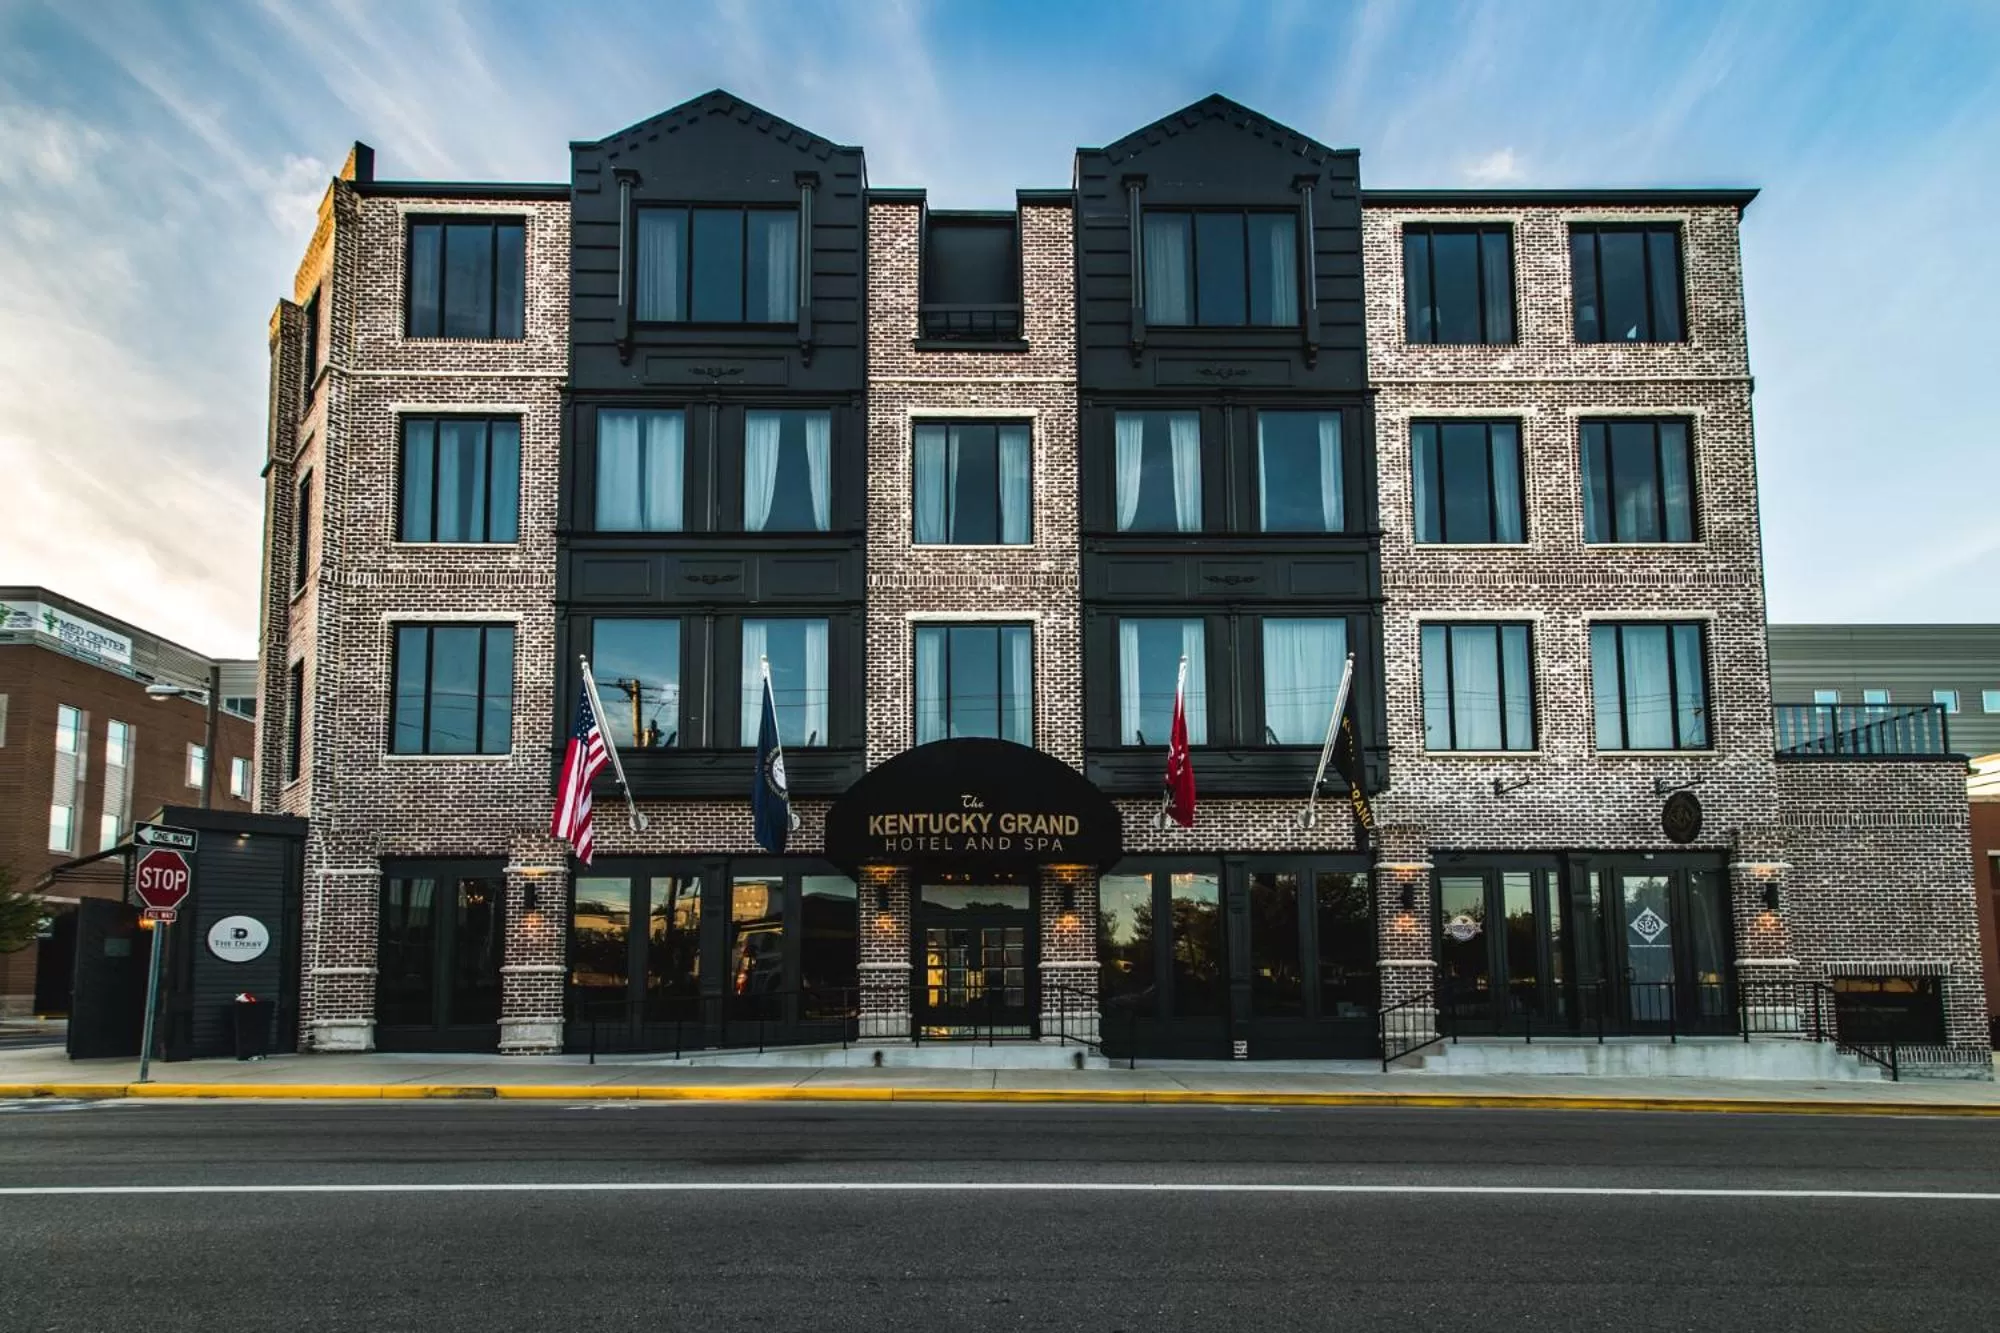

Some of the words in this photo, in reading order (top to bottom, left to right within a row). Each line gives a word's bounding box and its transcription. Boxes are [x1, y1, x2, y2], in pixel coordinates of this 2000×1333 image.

[60, 619, 85, 637] MED
[86, 630, 126, 652] CENTER
[961, 794, 984, 808] The
[869, 812, 993, 836] KENTUCKY
[1000, 812, 1080, 836] GRAND
[152, 831, 169, 842] ONE
[172, 834, 190, 845] WAY
[885, 837, 953, 851] HOTEL
[965, 837, 1011, 850] AND
[1023, 837, 1063, 851] SPA
[140, 866, 187, 891] STOP
[1638, 919, 1658, 932] SPA
